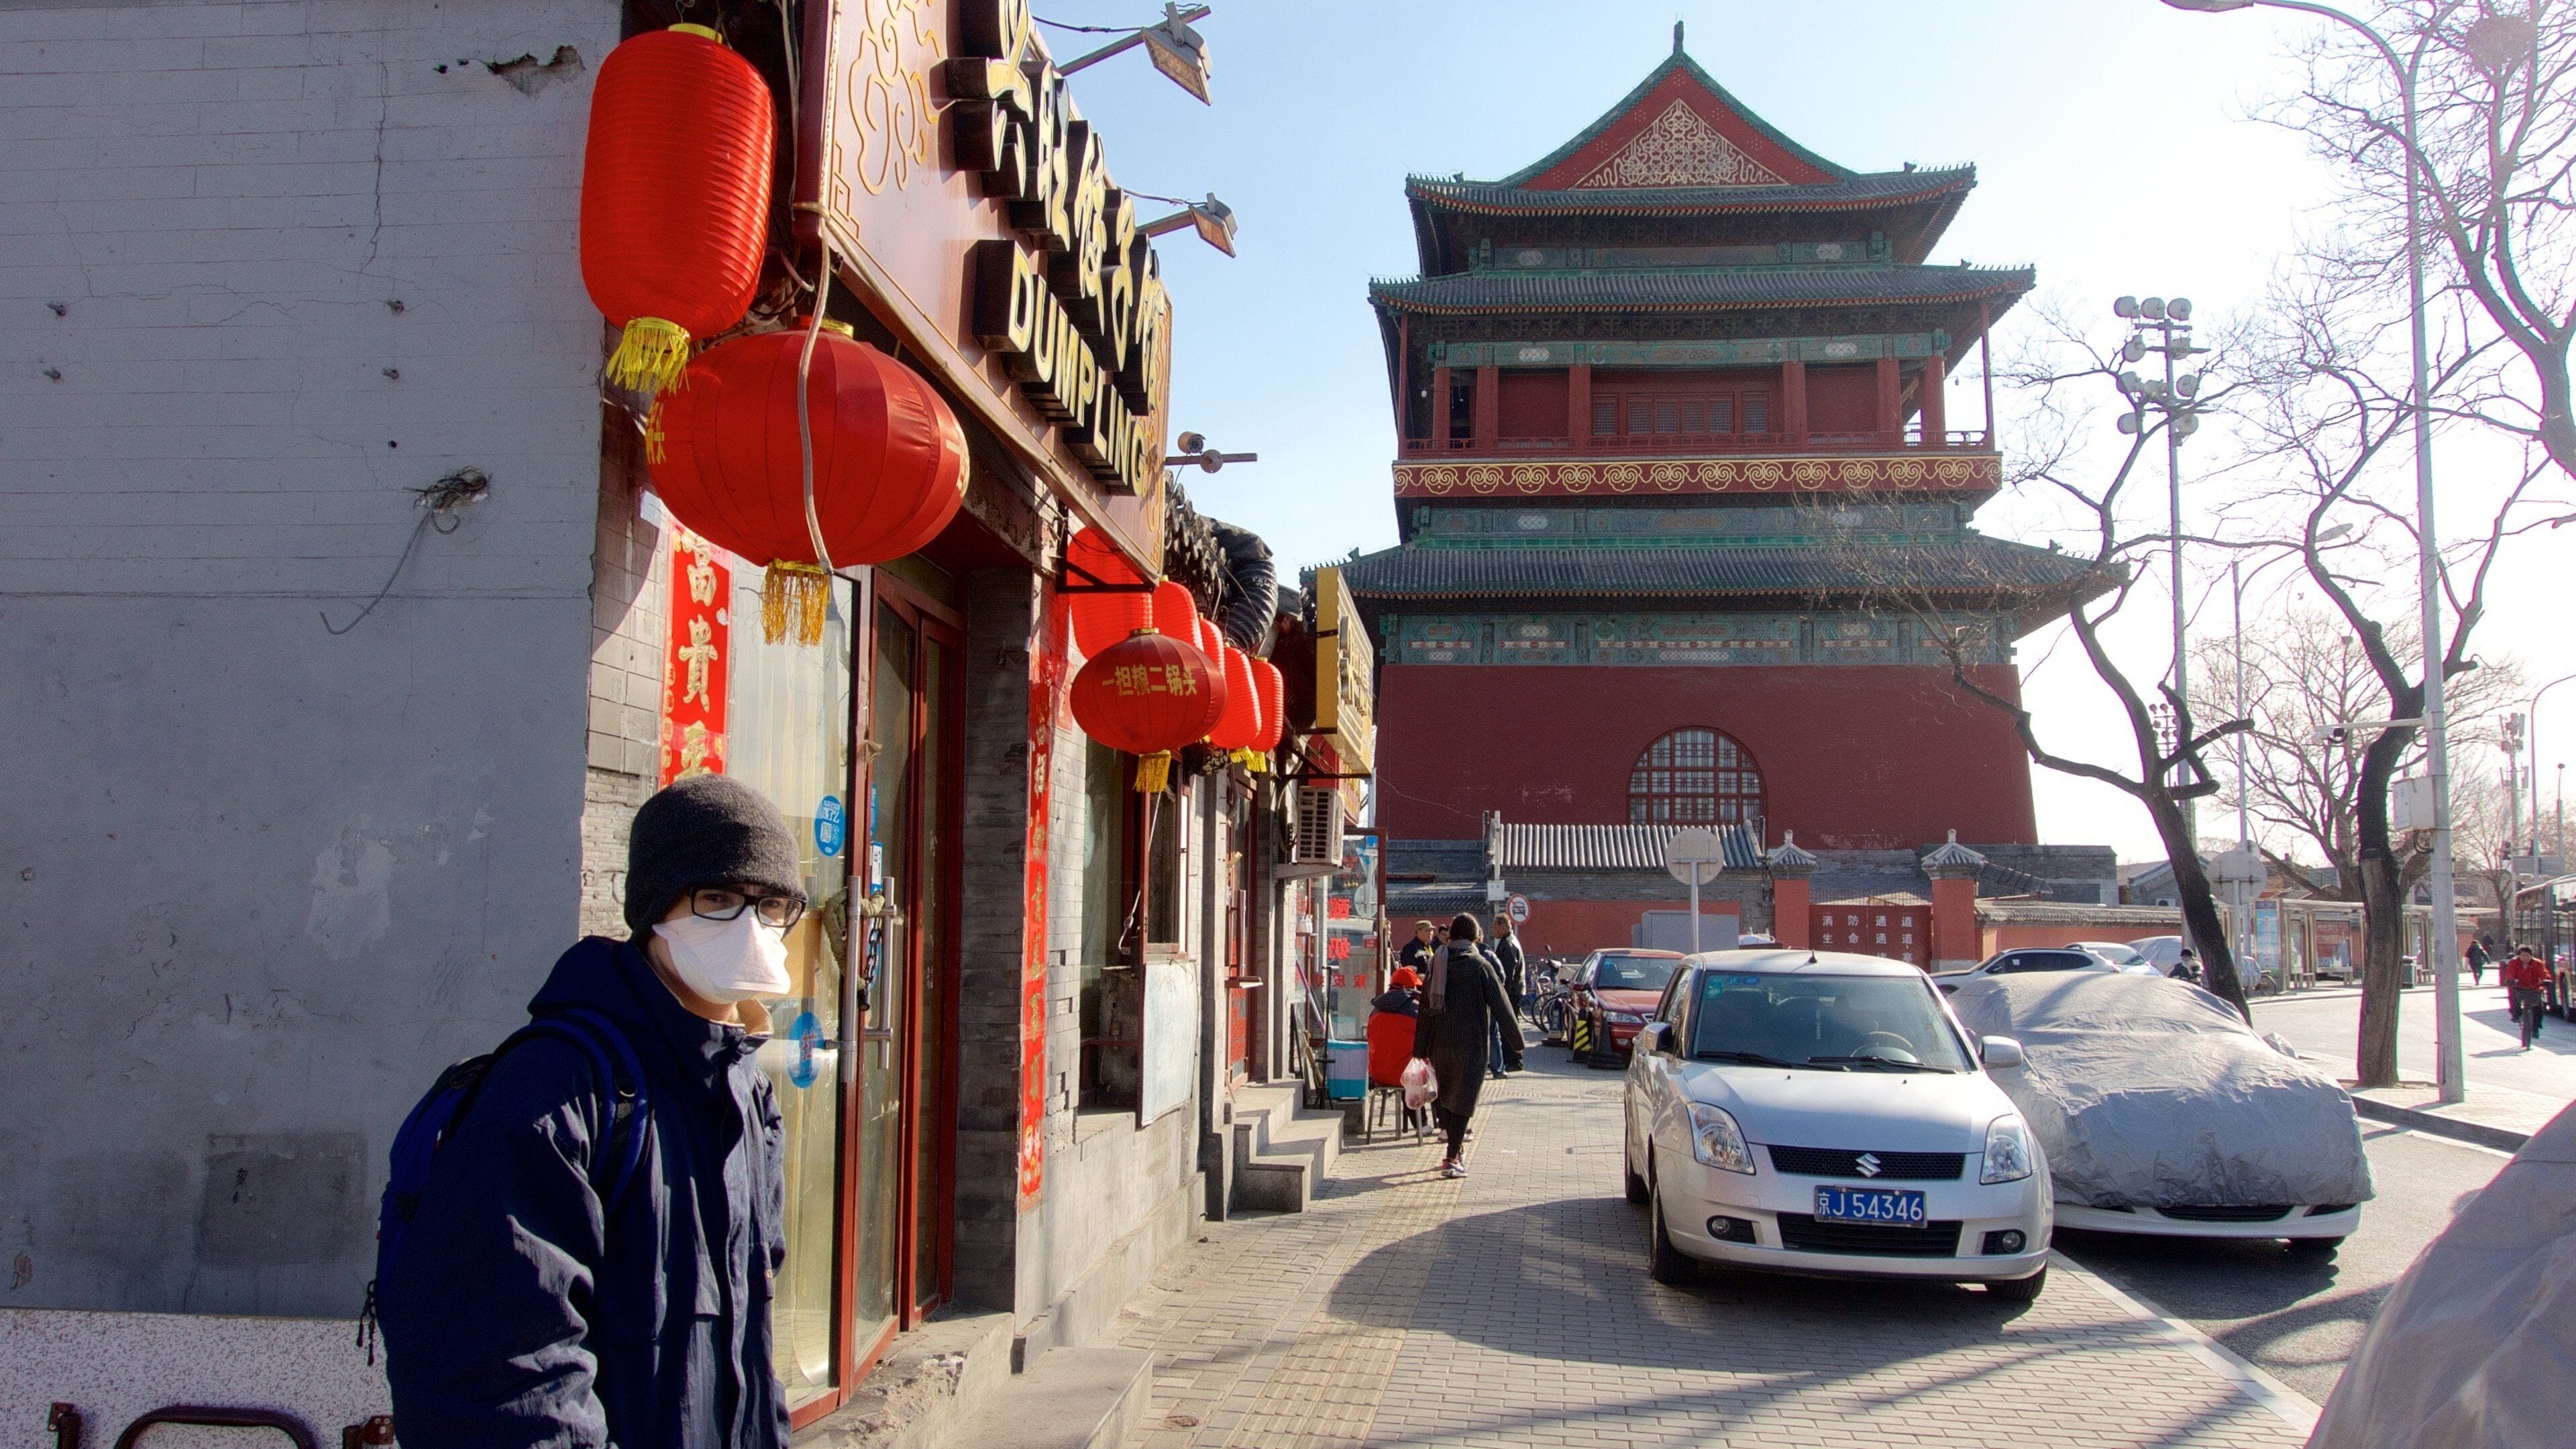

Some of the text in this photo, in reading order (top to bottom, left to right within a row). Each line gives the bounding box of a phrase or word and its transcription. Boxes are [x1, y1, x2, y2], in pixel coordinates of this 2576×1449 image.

[1008, 240, 1143, 497] DUMPLING
[1102, 663, 1197, 696] 一担粮二锅头
[1822, 915, 1913, 928] 消防通道
[1822, 932, 1913, 945] 生命通道
